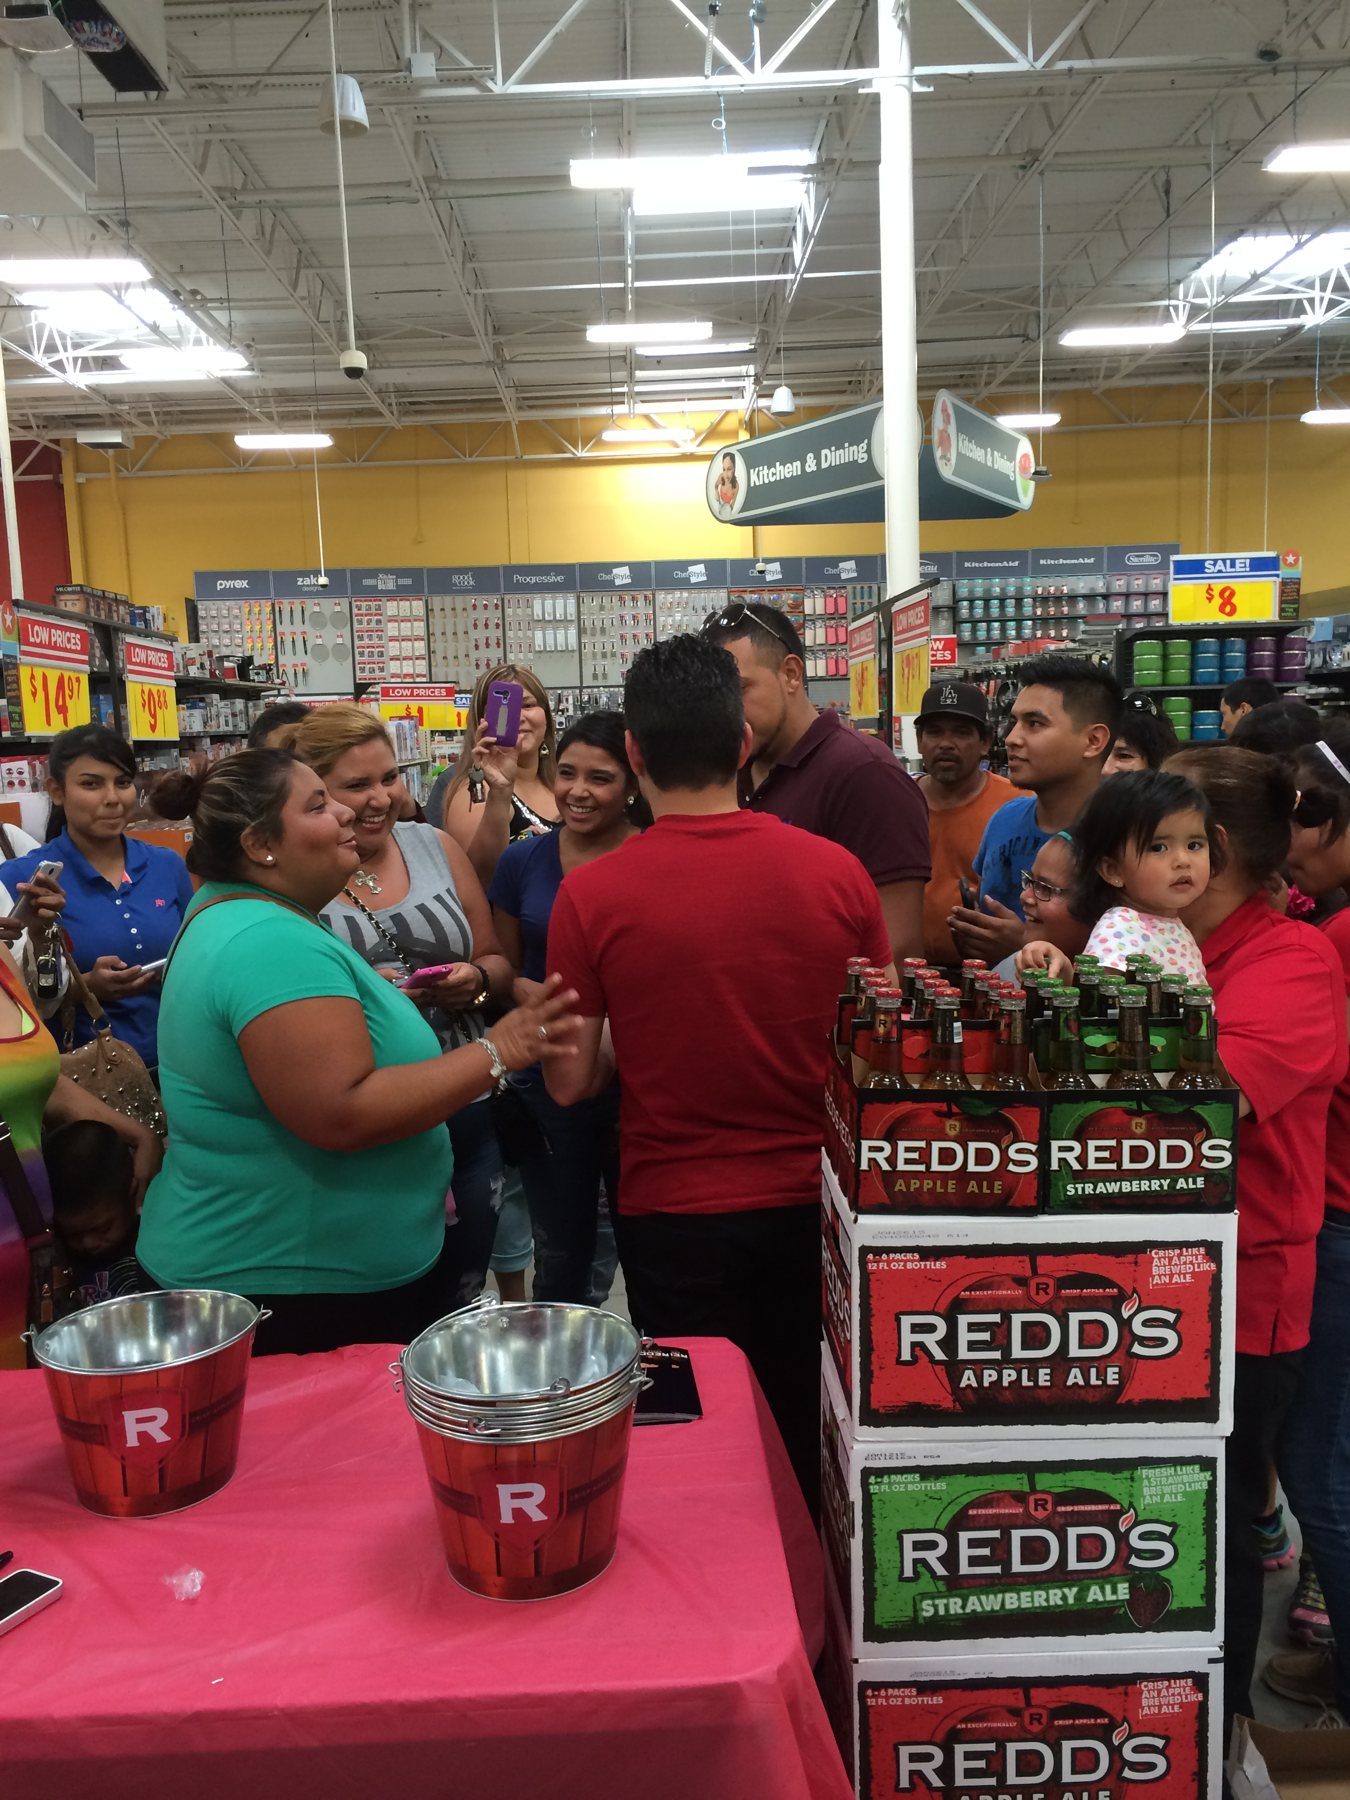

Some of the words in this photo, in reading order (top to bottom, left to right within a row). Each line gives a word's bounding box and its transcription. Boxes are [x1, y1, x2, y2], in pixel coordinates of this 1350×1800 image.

[750, 460, 801, 487] Kitchen
[805, 452, 817, 473] &
[821, 438, 868, 469] Dining
[958, 432, 985, 464] Kitchen
[986, 447, 993, 468] &
[993, 450, 1015, 481] Dining
[964, 560, 1020, 568] KitchenAid
[1039, 557, 1096, 565] KitchenAid
[1129, 553, 1159, 563] Sterilite
[1204, 559, 1250, 573] SALE!
[217, 579, 249, 590] pyrex
[452, 572, 472, 584] good
[456, 579, 476, 587] cook
[513, 573, 563, 584] Progressive
[896, 614, 907, 632] LOW
[907, 605, 925, 627] PRICES
[28, 624, 49, 645] LOW
[51, 628, 81, 650] PRICES
[131, 646, 146, 663] LOW
[147, 649, 168, 668] PRICES
[456, 697, 471, 705] SAL
[940, 685, 958, 704] LA
[859, 1134, 1039, 1173] REDD'S
[1050, 1132, 1233, 1171] REDD'S
[894, 1178, 957, 1193] APPLE
[966, 1180, 1003, 1194] ALE
[1066, 1178, 1172, 1196] STRAWBERRY
[1175, 1176, 1205, 1190] ALE
[889, 1252, 920, 1260] PACKS
[1151, 1248, 1180, 1257] CRISP
[1182, 1247, 1206, 1255] LIKE
[906, 1261, 947, 1269] BOTTLES
[1152, 1257, 1170, 1266] AN
[1171, 1256, 1206, 1265] APPLE.
[1151, 1265, 1194, 1275] BREWED
[1194, 1262, 1217, 1271] LIKE
[1152, 1275, 1170, 1284] AN
[1171, 1274, 1195, 1284] ALE.
[1035, 1281, 1050, 1296] R
[899, 1304, 1180, 1361] REDD'S
[959, 1366, 1051, 1388] APPLE
[1066, 1366, 1120, 1386] ALE
[122, 1407, 171, 1447] R
[1142, 1466, 1174, 1478] FRESH
[1176, 1465, 1200, 1474] LIKE
[890, 1474, 920, 1483] PACKS
[1150, 1471, 1213, 1486] STRAWBERRY.
[869, 1485, 879, 1493] 12
[892, 1484, 906, 1492] OZ
[907, 1483, 947, 1491] BOTTLES
[1142, 1485, 1185, 1496] BREWED
[1185, 1481, 1208, 1491] LIKE
[496, 1482, 548, 1524] R
[1034, 1498, 1048, 1512] R
[1143, 1494, 1161, 1504] AN
[1163, 1494, 1186, 1503] ALE.
[901, 1519, 1175, 1578] REDD'S
[921, 1587, 1079, 1618] STRAWBERRY
[1086, 1582, 1130, 1601] ALE
[1141, 1681, 1169, 1690] CRISP
[1170, 1679, 1193, 1688] LIKE
[888, 1688, 917, 1696] PACKS
[1141, 1690, 1158, 1698] AN
[1160, 1687, 1194, 1697] APPLE.
[866, 1698, 877, 1706] 12
[904, 1696, 943, 1704] BOTTLES
[1141, 1696, 1181, 1706] BREWED
[1182, 1693, 1203, 1702] LIKE
[1142, 1706, 1158, 1715] AN
[1161, 1705, 1182, 1714] ALE.
[1029, 1712, 1043, 1726] R
[898, 1732, 1168, 1789] REDD'S
